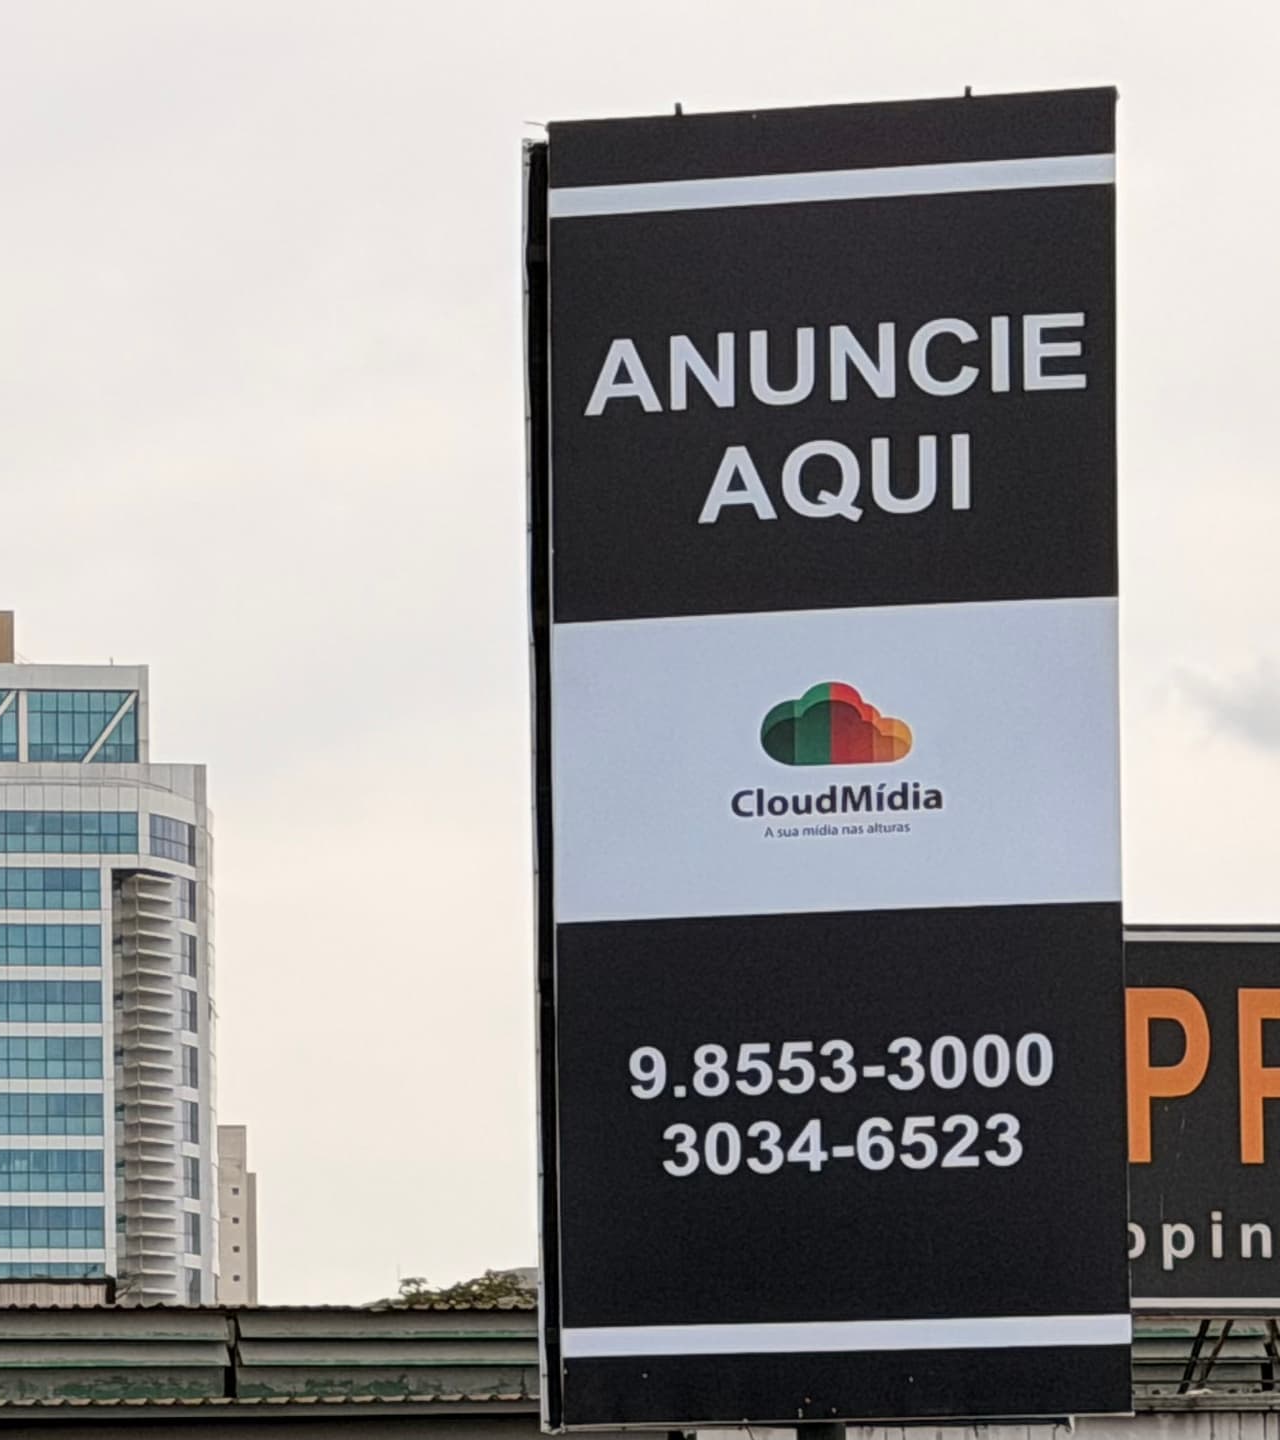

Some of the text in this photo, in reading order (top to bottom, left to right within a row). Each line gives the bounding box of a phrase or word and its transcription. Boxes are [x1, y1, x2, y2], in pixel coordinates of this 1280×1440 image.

[584, 311, 1088, 416] ANUNCIE
[697, 433, 971, 523] AQUI
[731, 782, 944, 818] CloudMídia
[764, 822, 911, 838] A sua mídia nas alturas
[628, 1032, 1054, 1099] 9.8553-3000
[662, 1113, 1024, 1176] 3034-6523
